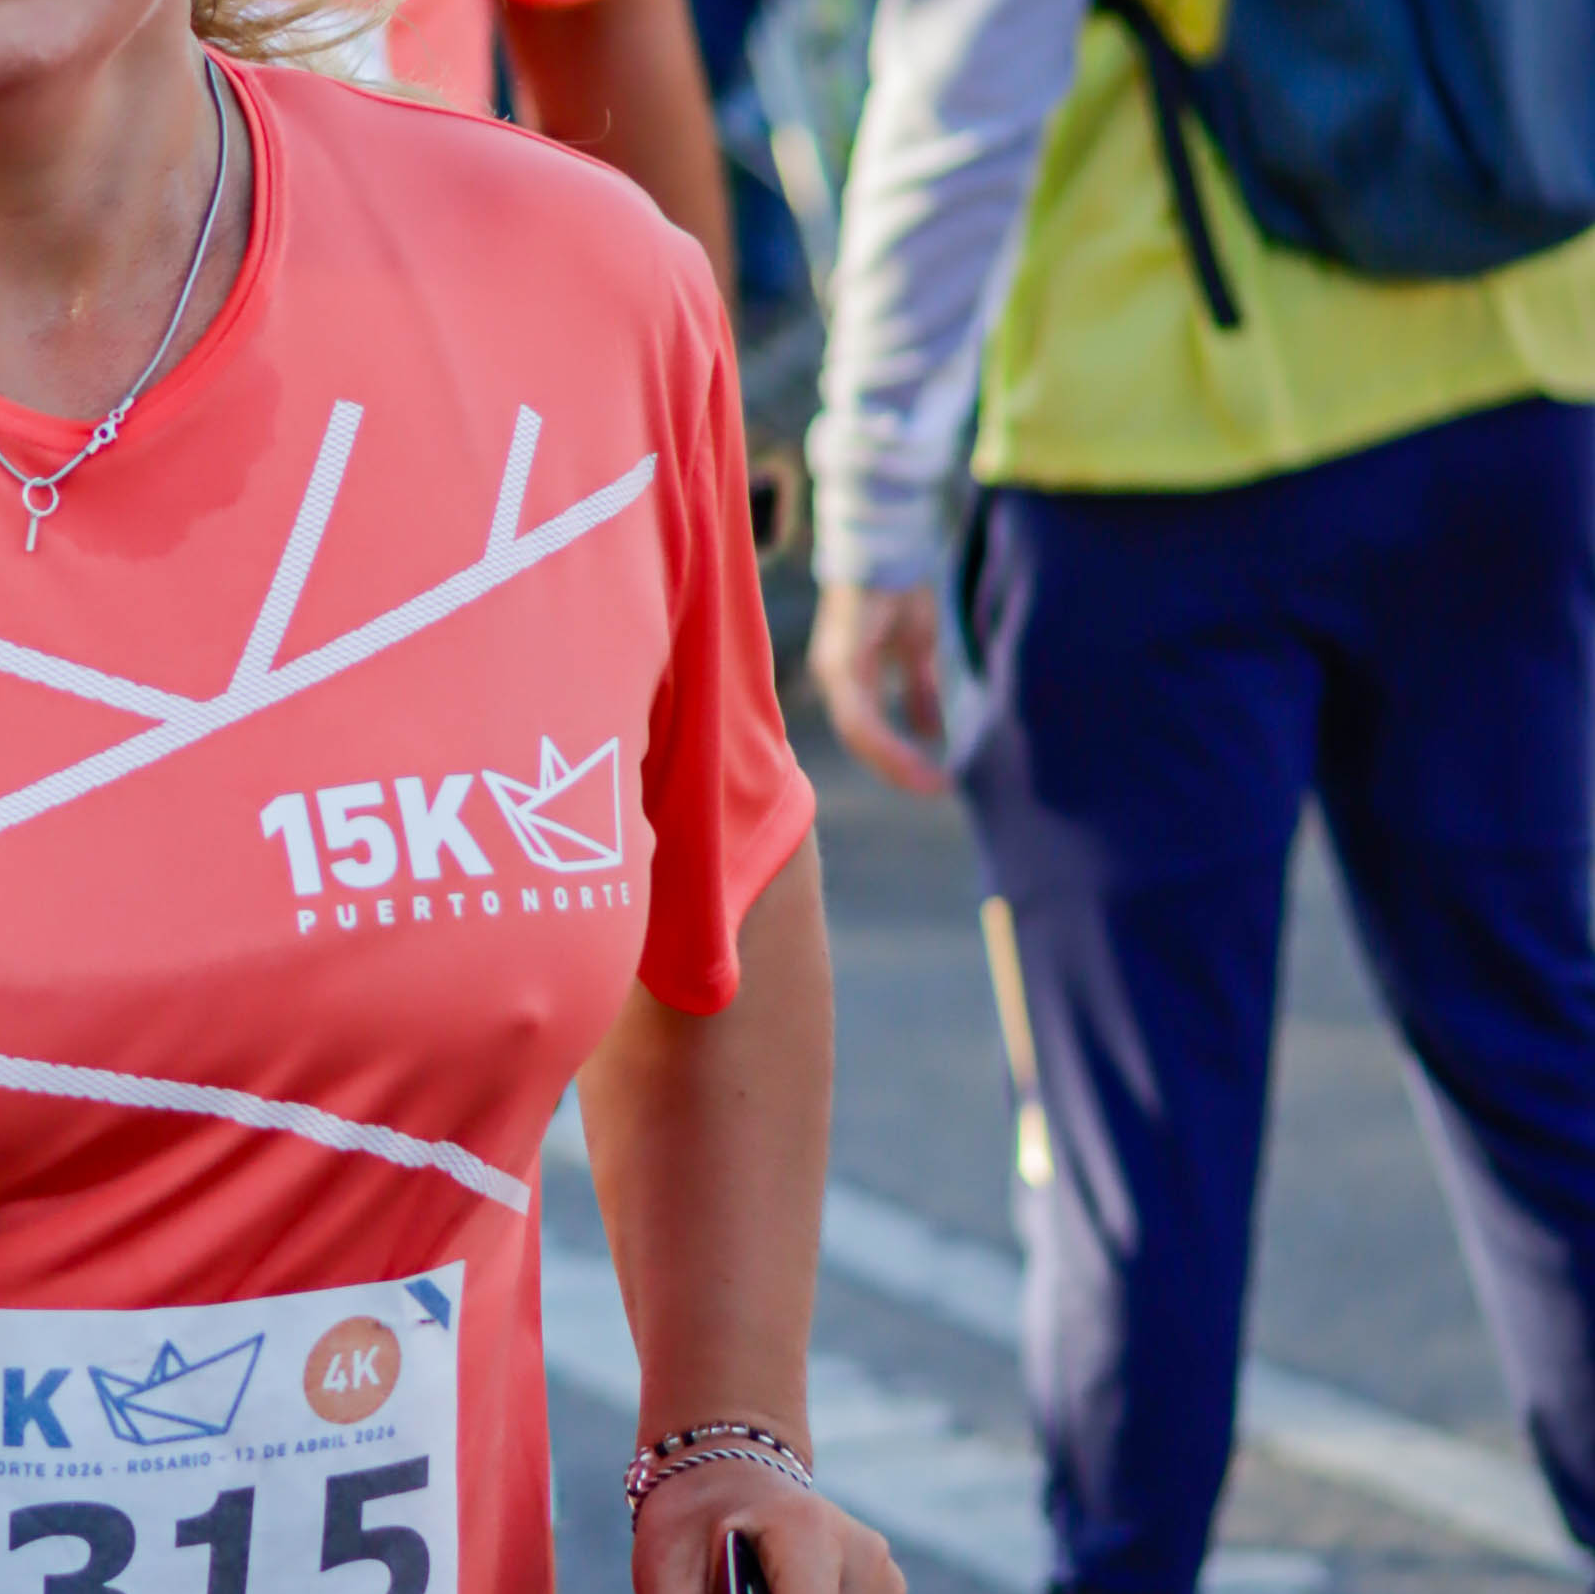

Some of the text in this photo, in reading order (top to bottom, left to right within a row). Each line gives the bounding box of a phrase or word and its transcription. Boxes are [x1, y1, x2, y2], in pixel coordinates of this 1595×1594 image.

[259, 772, 495, 896] 15K
[297, 881, 632, 934] PUERTO NORTE
[322, 1344, 380, 1395] 4K
[55, 1461, 103, 1478] 2026
[127, 1452, 212, 1474] ROSARIO
[263, 1442, 287, 1459] DE
[295, 1435, 347, 1455] ABRIL
[355, 1423, 396, 1445] 2026
